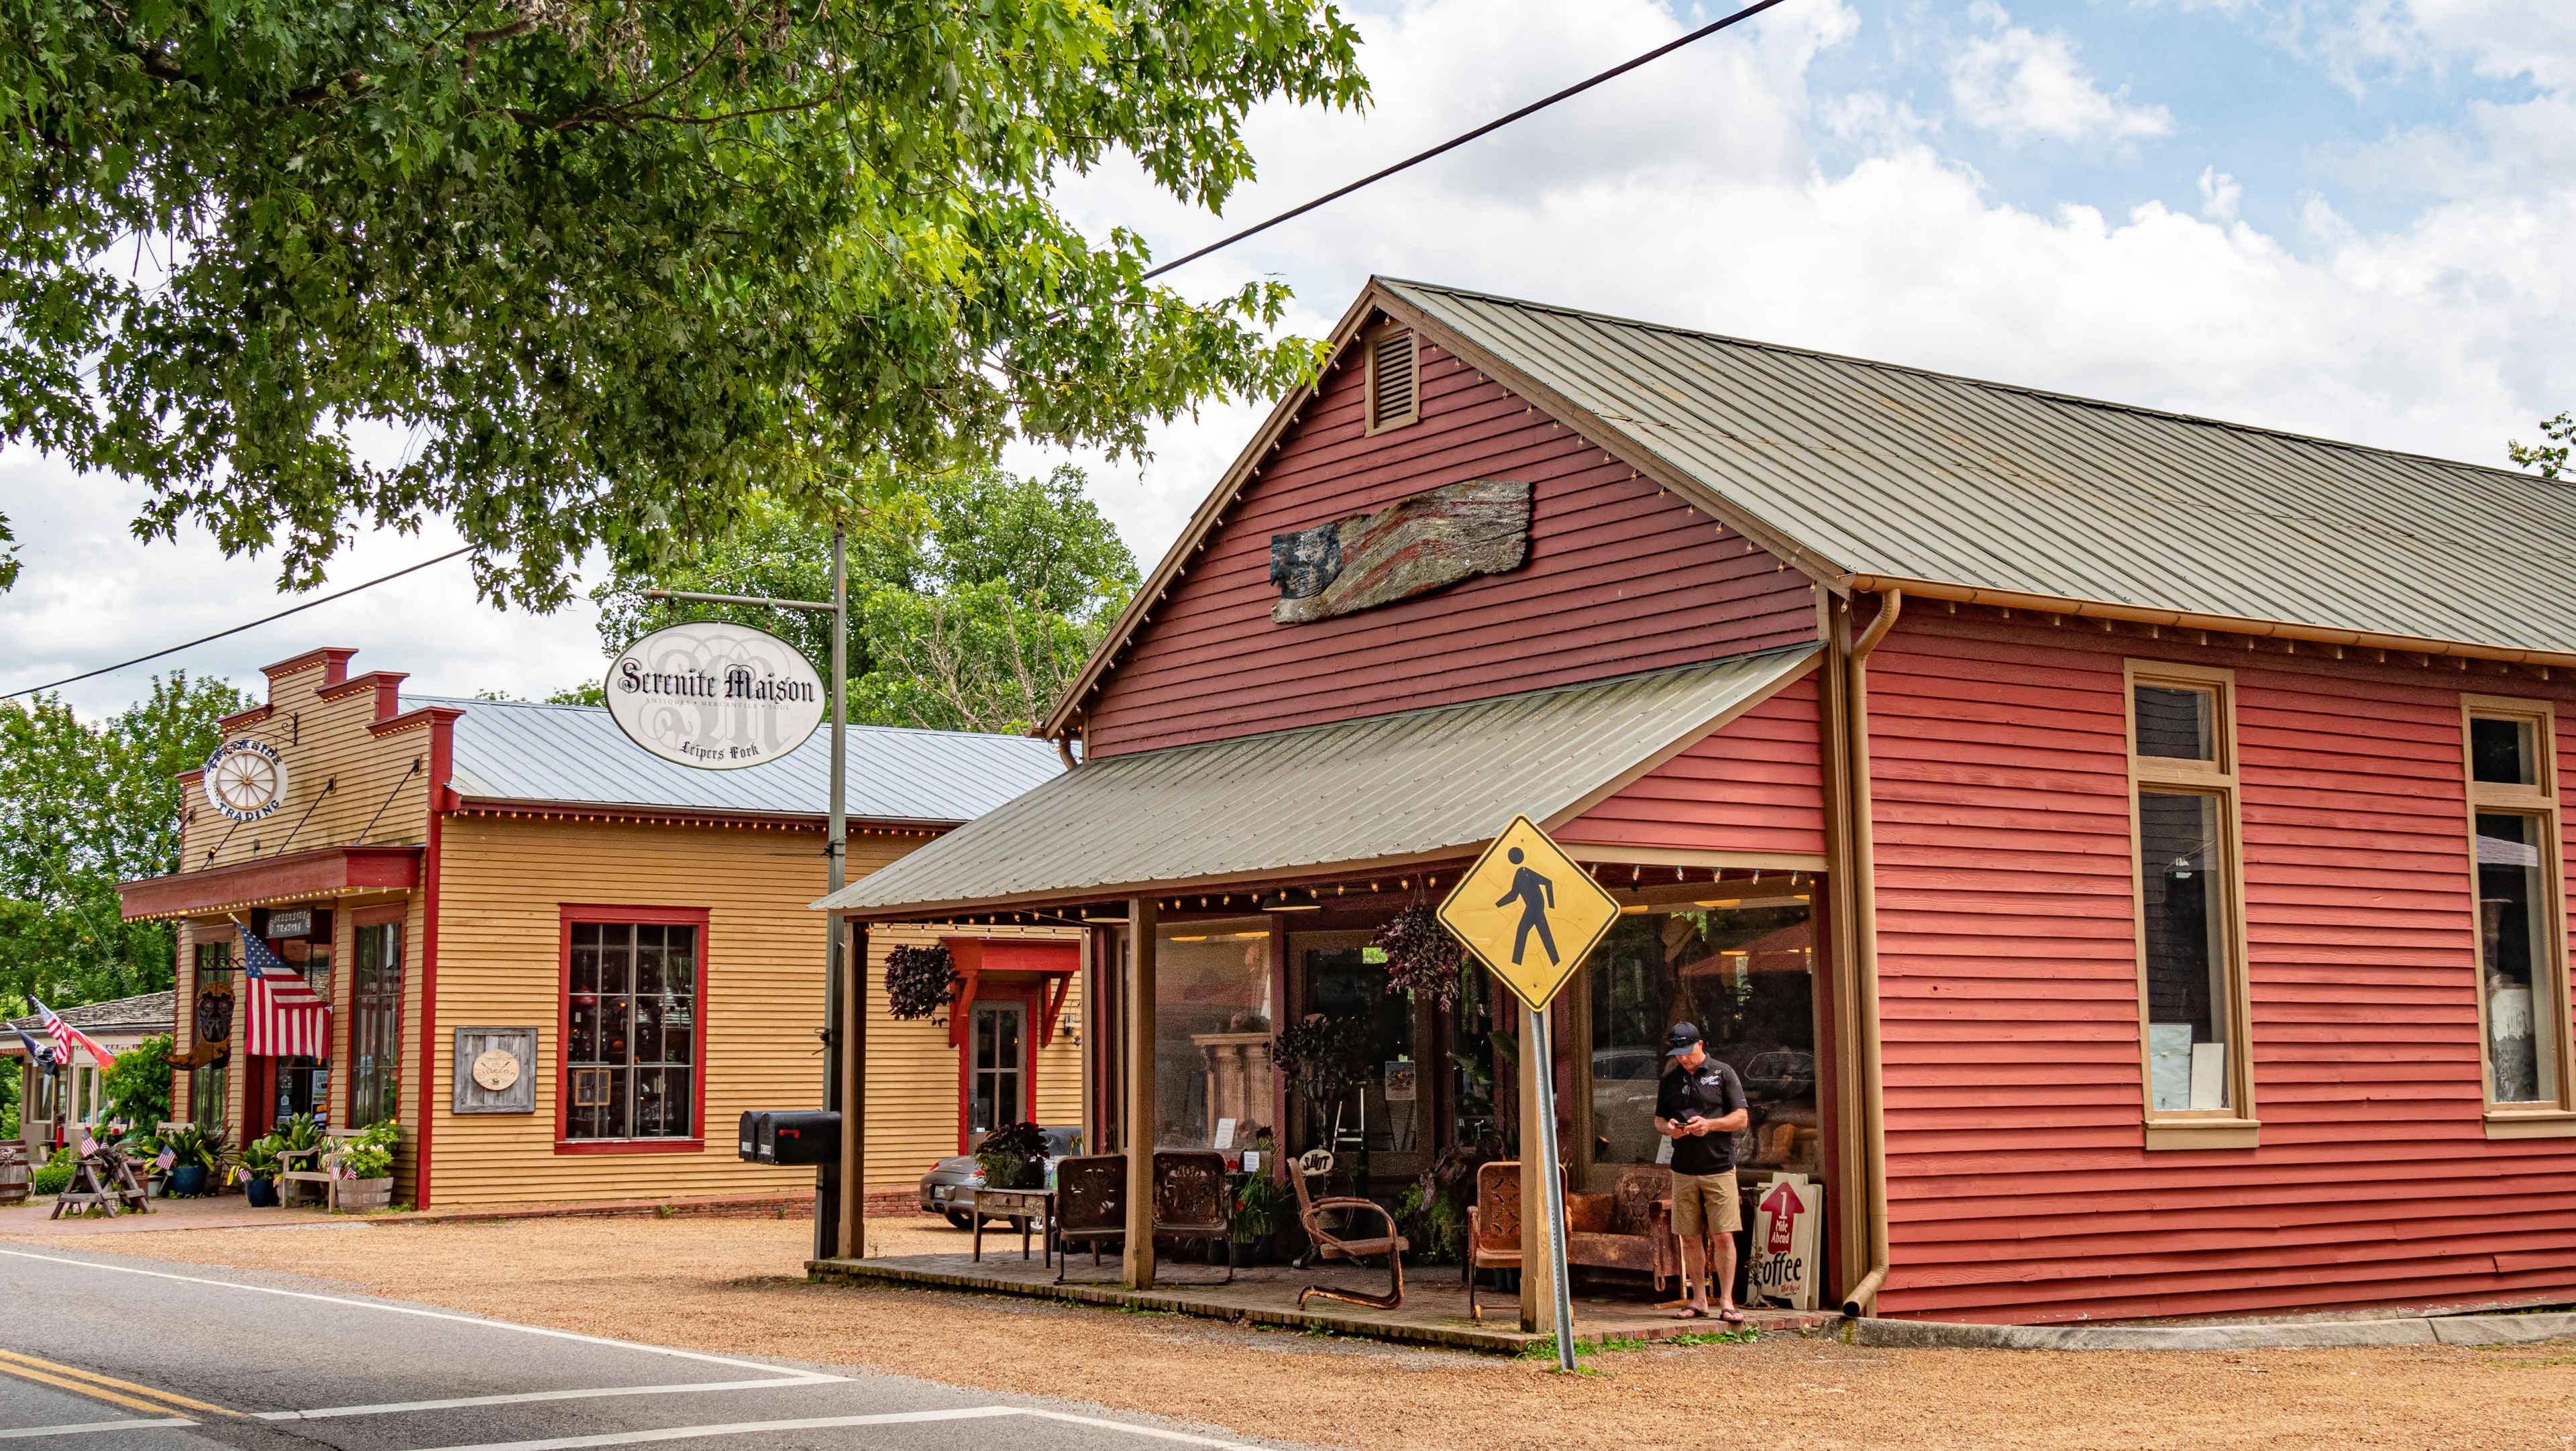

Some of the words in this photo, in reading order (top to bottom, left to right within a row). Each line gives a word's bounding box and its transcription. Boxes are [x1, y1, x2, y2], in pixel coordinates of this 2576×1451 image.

[617, 657, 716, 698] Serenite
[724, 663, 816, 704] Maison
[645, 698, 690, 706] ANTIQUES
[701, 700, 758, 709] MERCANTILE
[679, 741, 724, 762] Leipers
[729, 741, 760, 759] Fork
[218, 799, 280, 821] TRADING
[1778, 1191, 1788, 1220] 1
[1775, 1220, 1788, 1233] Mile
[1771, 1231, 1790, 1244] Ahead
[1755, 1252, 1802, 1287] offee
